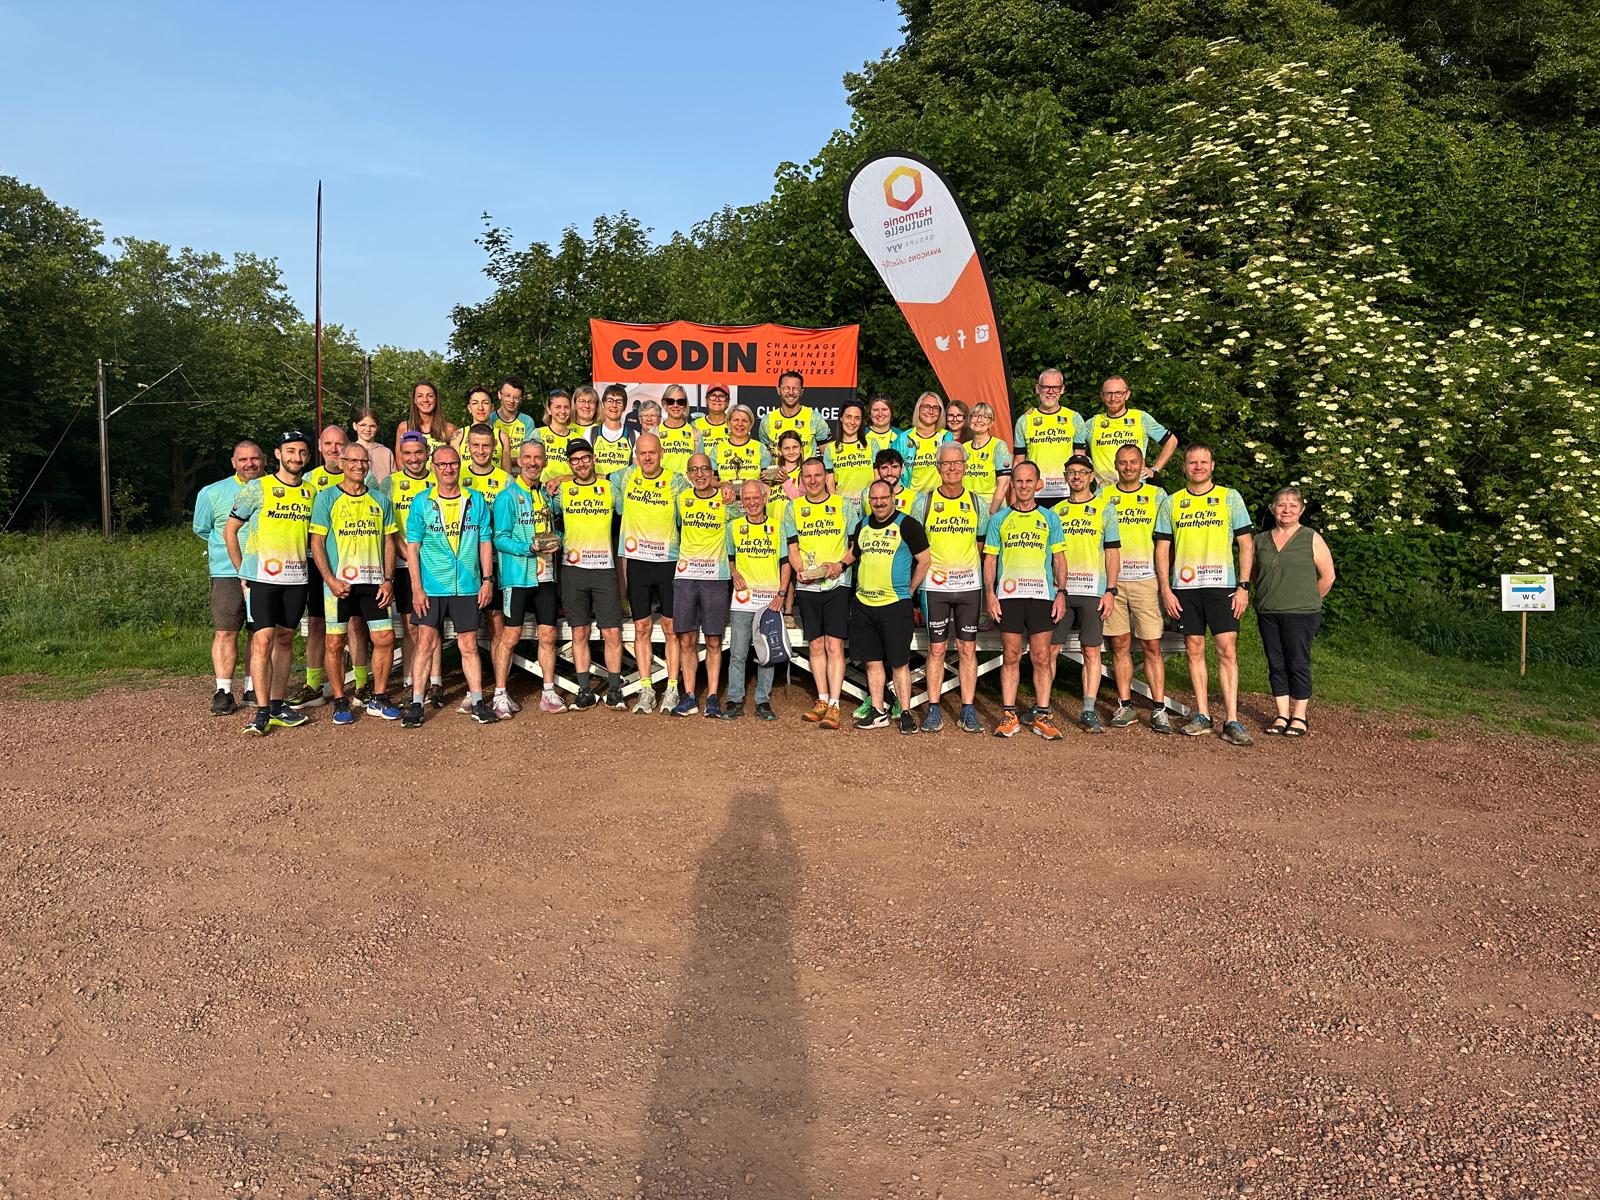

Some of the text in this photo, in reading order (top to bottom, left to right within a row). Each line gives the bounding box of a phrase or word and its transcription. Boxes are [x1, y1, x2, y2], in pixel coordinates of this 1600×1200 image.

[766, 342, 836, 350] CHAUFFAGE
[612, 339, 757, 373] GODIN
[766, 350, 836, 358] CHEMINÉES
[766, 359, 835, 367] CUISINES
[756, 405, 840, 420] CHAGE
[1034, 429, 1046, 437] Les
[1101, 431, 1113, 439] Les
[546, 446, 558, 454] Les
[276, 502, 311, 513] Les Ch'tis
[583, 499, 604, 508] Ch'tis
[565, 507, 610, 515] Marathoniens
[685, 511, 695, 519] Les
[1125, 508, 1147, 517] Ch'tis
[1180, 510, 1217, 520] Les Ch'tis
[344, 520, 356, 529] Les
[803, 519, 835, 530] Les Ch'tis
[935, 516, 970, 526] Les Ch'tis
[1070, 518, 1092, 527] Ch'tis
[929, 525, 976, 534] Marathoniens
[1020, 531, 1041, 540] Ch'tis
